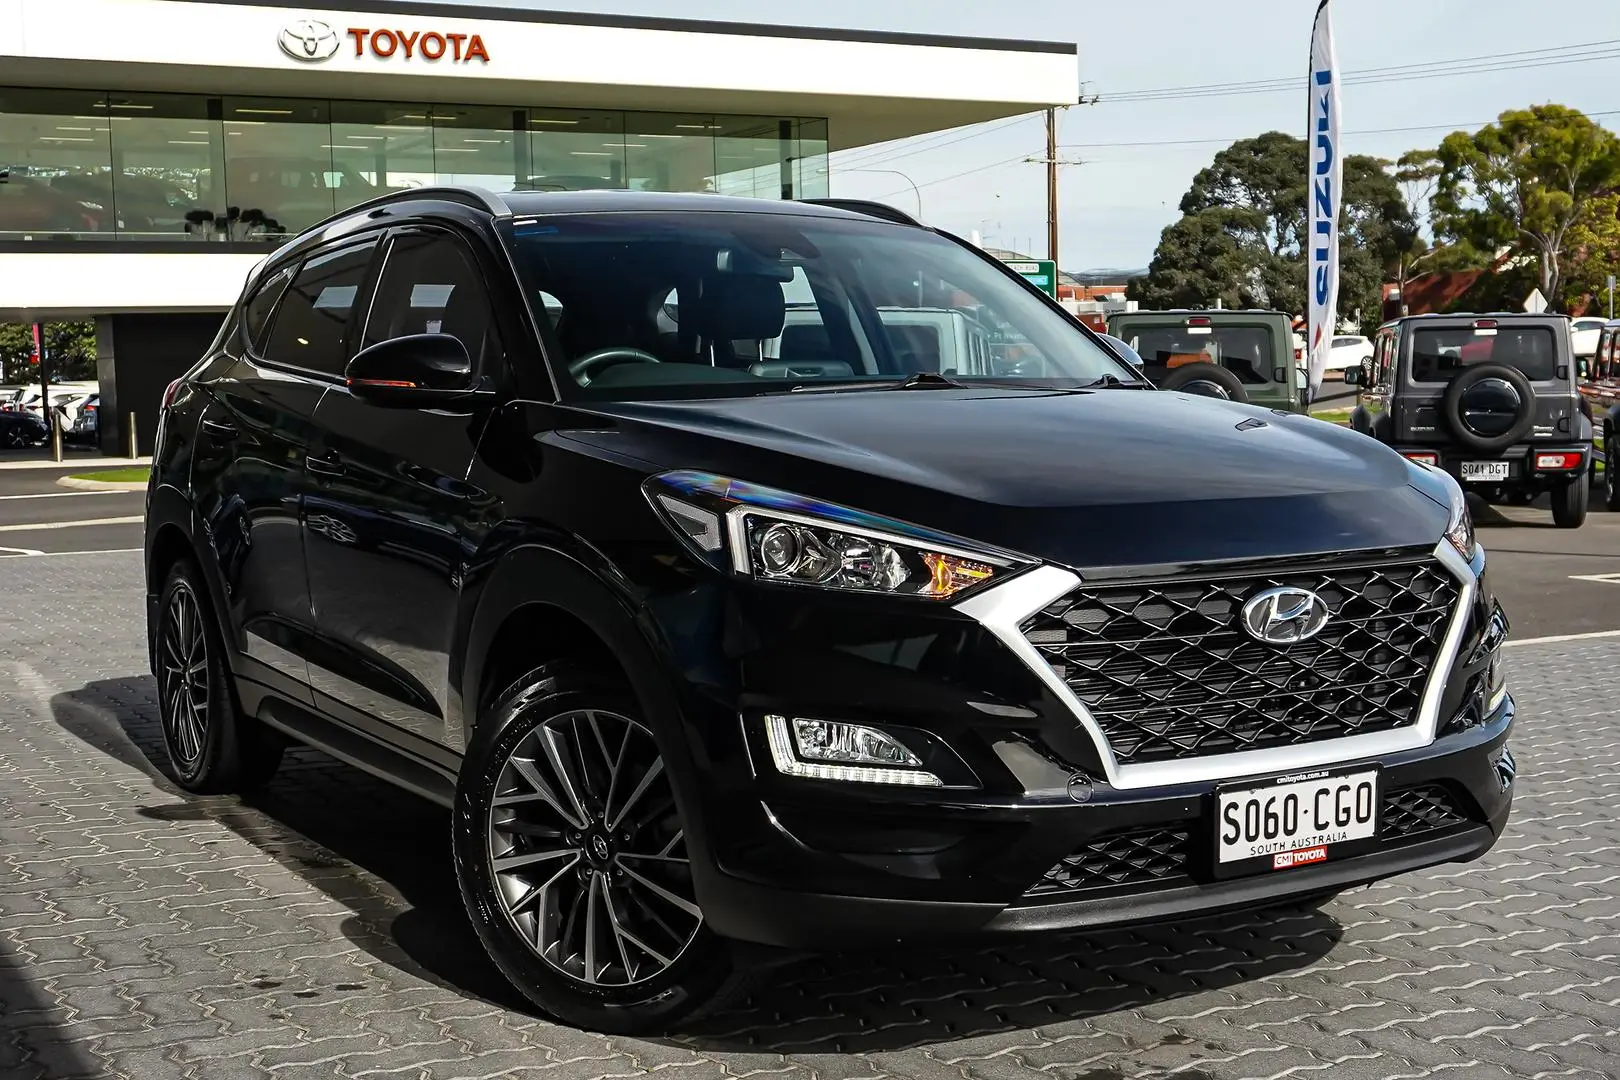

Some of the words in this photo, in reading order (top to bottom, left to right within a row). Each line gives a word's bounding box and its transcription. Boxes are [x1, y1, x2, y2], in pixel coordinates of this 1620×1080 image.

[347, 28, 490, 62] TOYOTA
[1315, 70, 1333, 305] SUZUKI
[1276, 771, 1330, 784] cmitoyota.com.au
[1250, 841, 1286, 856] SOUTH
[1290, 831, 1348, 849] AUSTRALIA
[1276, 854, 1292, 866] CMI
[1292, 848, 1327, 863] TOYOTA
